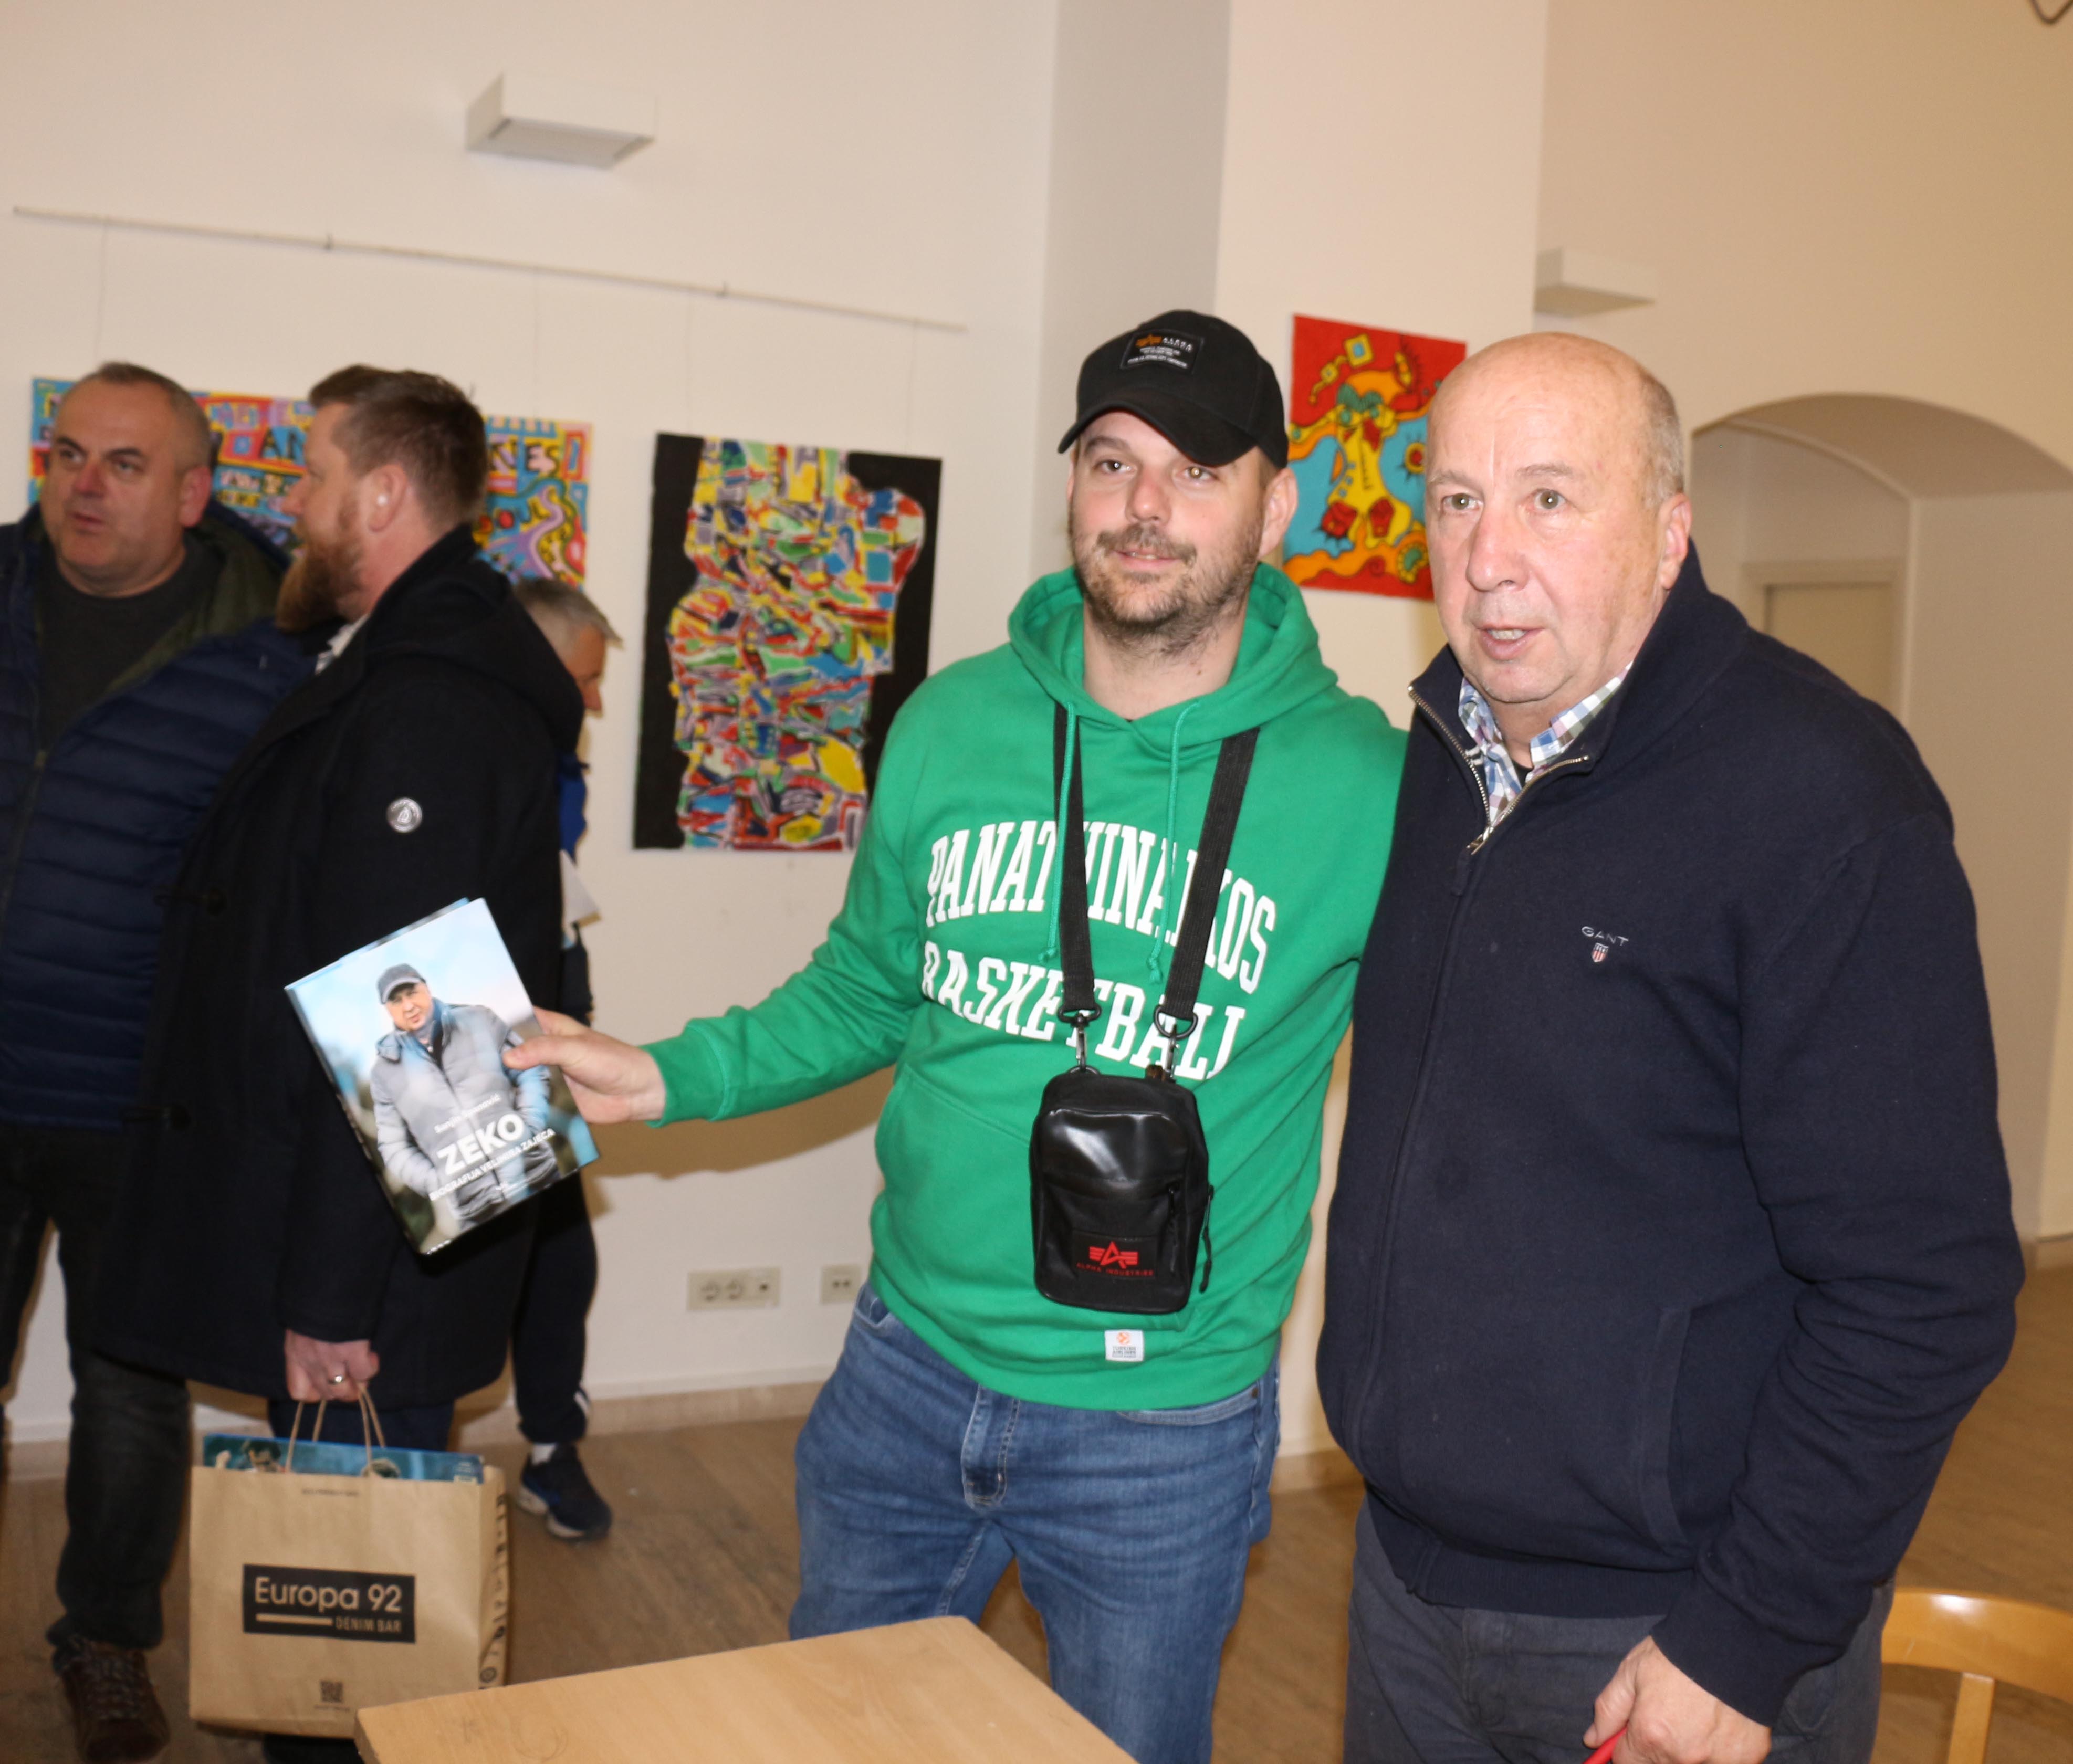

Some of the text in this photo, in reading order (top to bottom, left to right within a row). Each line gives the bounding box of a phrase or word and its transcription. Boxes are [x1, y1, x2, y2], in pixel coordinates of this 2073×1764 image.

[1582, 926, 1629, 946] GANT
[436, 1112, 525, 1176] ZEKO
[428, 1167, 481, 1201] BIOGRAFIJA
[480, 1146, 522, 1173] VELIMIRA
[520, 1128, 556, 1150] ZAJECA
[255, 1576, 402, 1613] Europa 92
[336, 1615, 402, 1633] DENIM BAR
